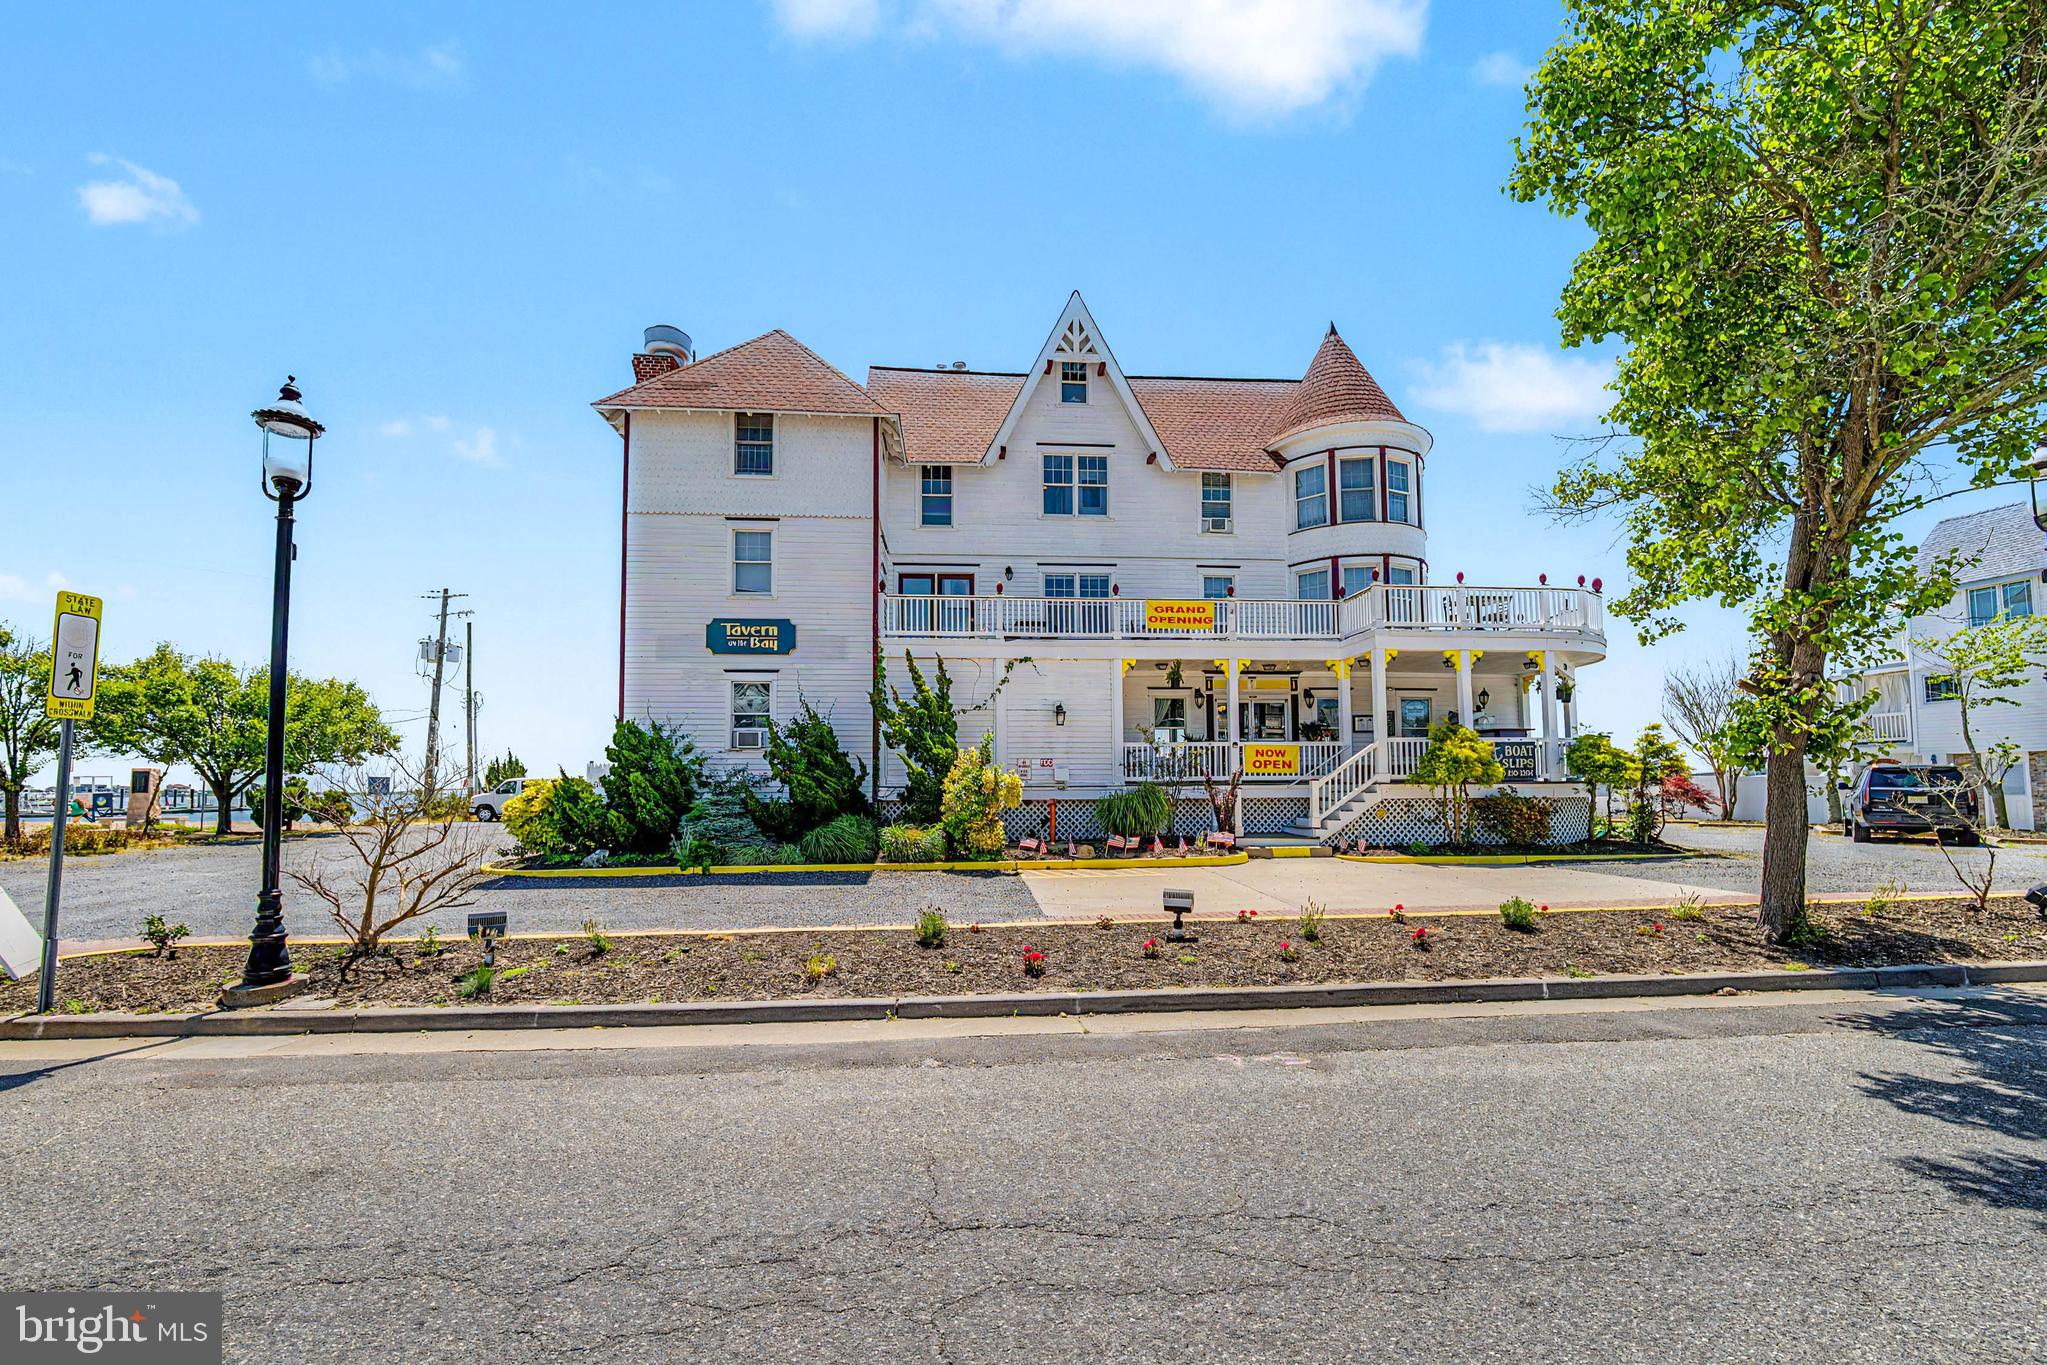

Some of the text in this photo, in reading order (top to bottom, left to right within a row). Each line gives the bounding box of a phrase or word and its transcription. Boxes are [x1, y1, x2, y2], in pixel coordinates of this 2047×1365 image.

[66, 594, 96, 608] STATE
[70, 604, 92, 616] LAW
[1154, 606, 1206, 614] GRAND
[1148, 616, 1213, 625] OPENING
[720, 623, 778, 636] Tavern
[750, 637, 778, 651] Bay
[68, 652, 83, 660] FOR
[59, 700, 84, 710] WITHIN
[48, 707, 92, 718] CROSSWALK
[1255, 749, 1286, 757] NOW
[1505, 745, 1534, 757] BOAT
[1252, 760, 1292, 769] OPEN
[1502, 758, 1534, 769] SLIPS
